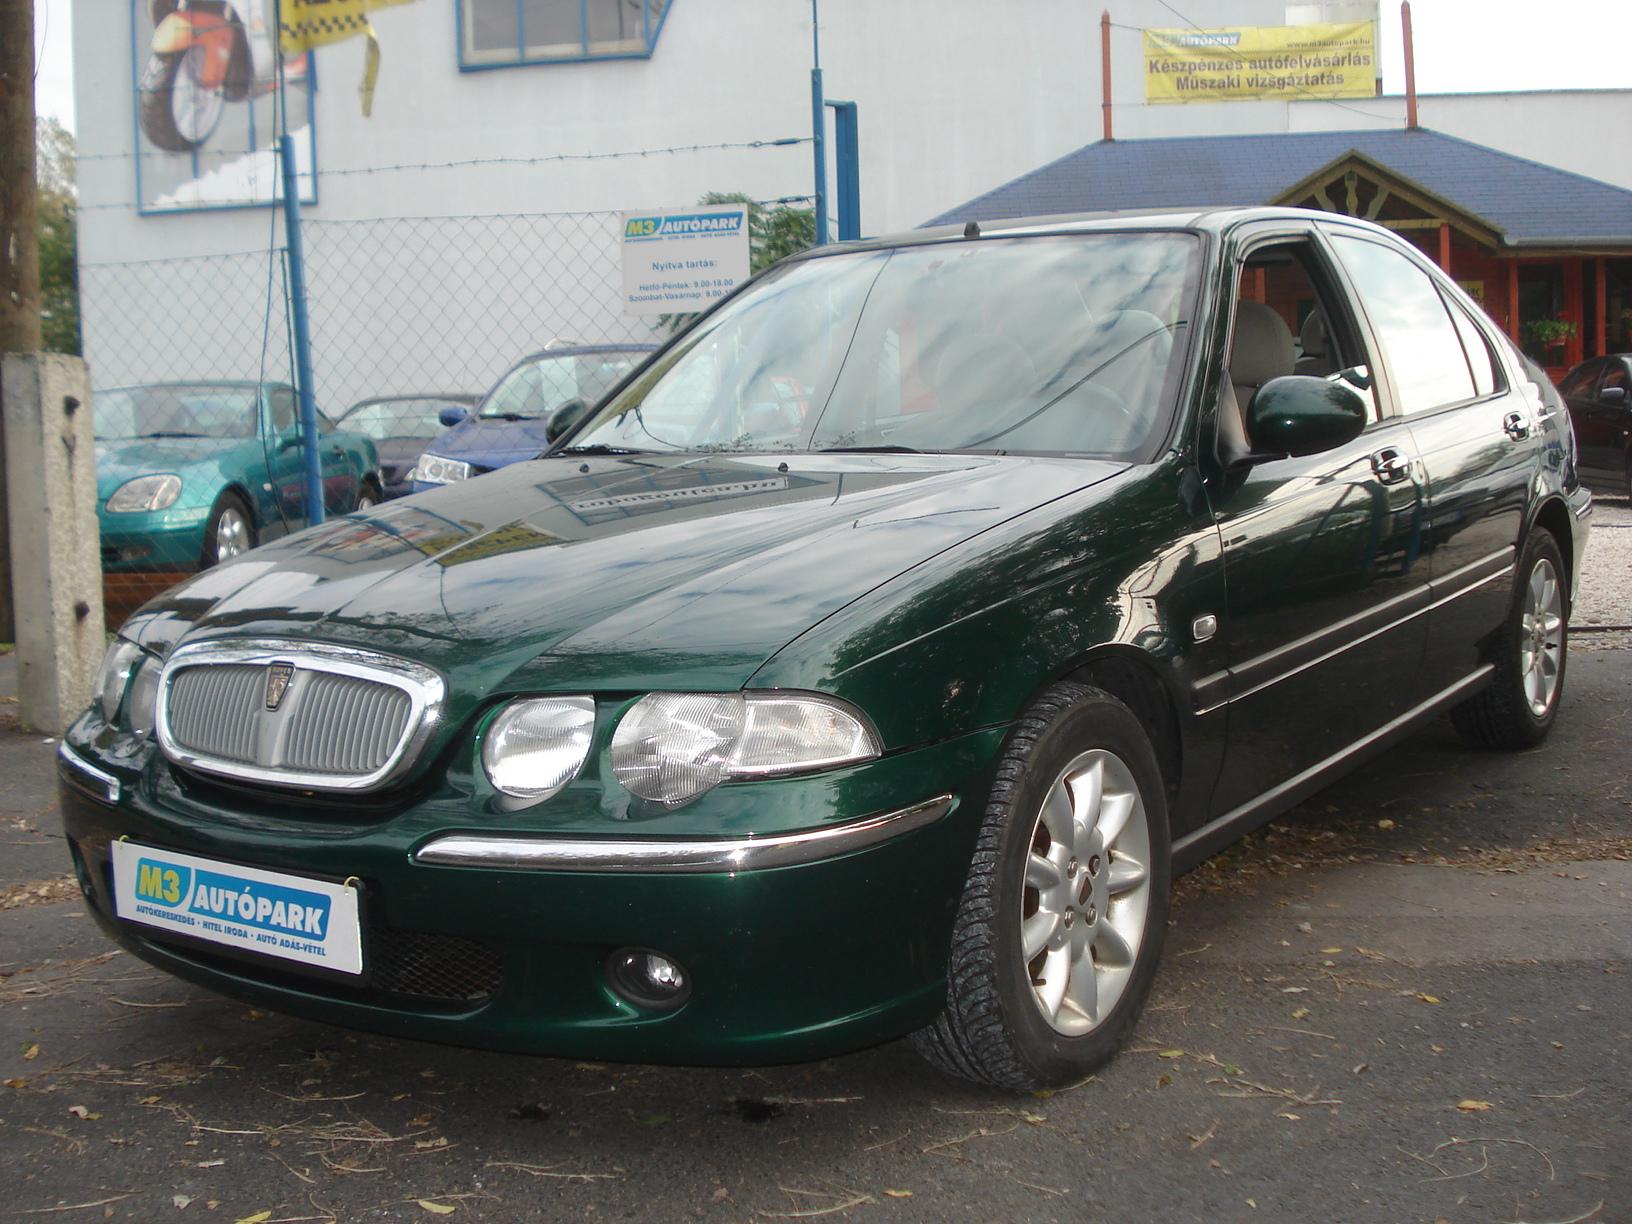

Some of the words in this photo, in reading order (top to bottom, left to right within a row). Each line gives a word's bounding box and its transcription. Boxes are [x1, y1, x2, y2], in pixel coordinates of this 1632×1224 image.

[1148, 57, 1244, 76] Készpénzes
[1248, 51, 1371, 70] autófelvásárlás
[1246, 69, 1345, 90] vizsgáztatás
[626, 219, 656, 236] M3
[661, 216, 738, 233] AUTÓPARK
[651, 261, 684, 272] Nyitva
[139, 864, 181, 903] M3
[194, 884, 325, 935] AUTÓPARK
[202, 920, 223, 933] HITEL
[224, 925, 248, 940] IRODA
[256, 933, 279, 946] AUTÓ
[279, 938, 327, 957] ADÁS-VÉTEL
